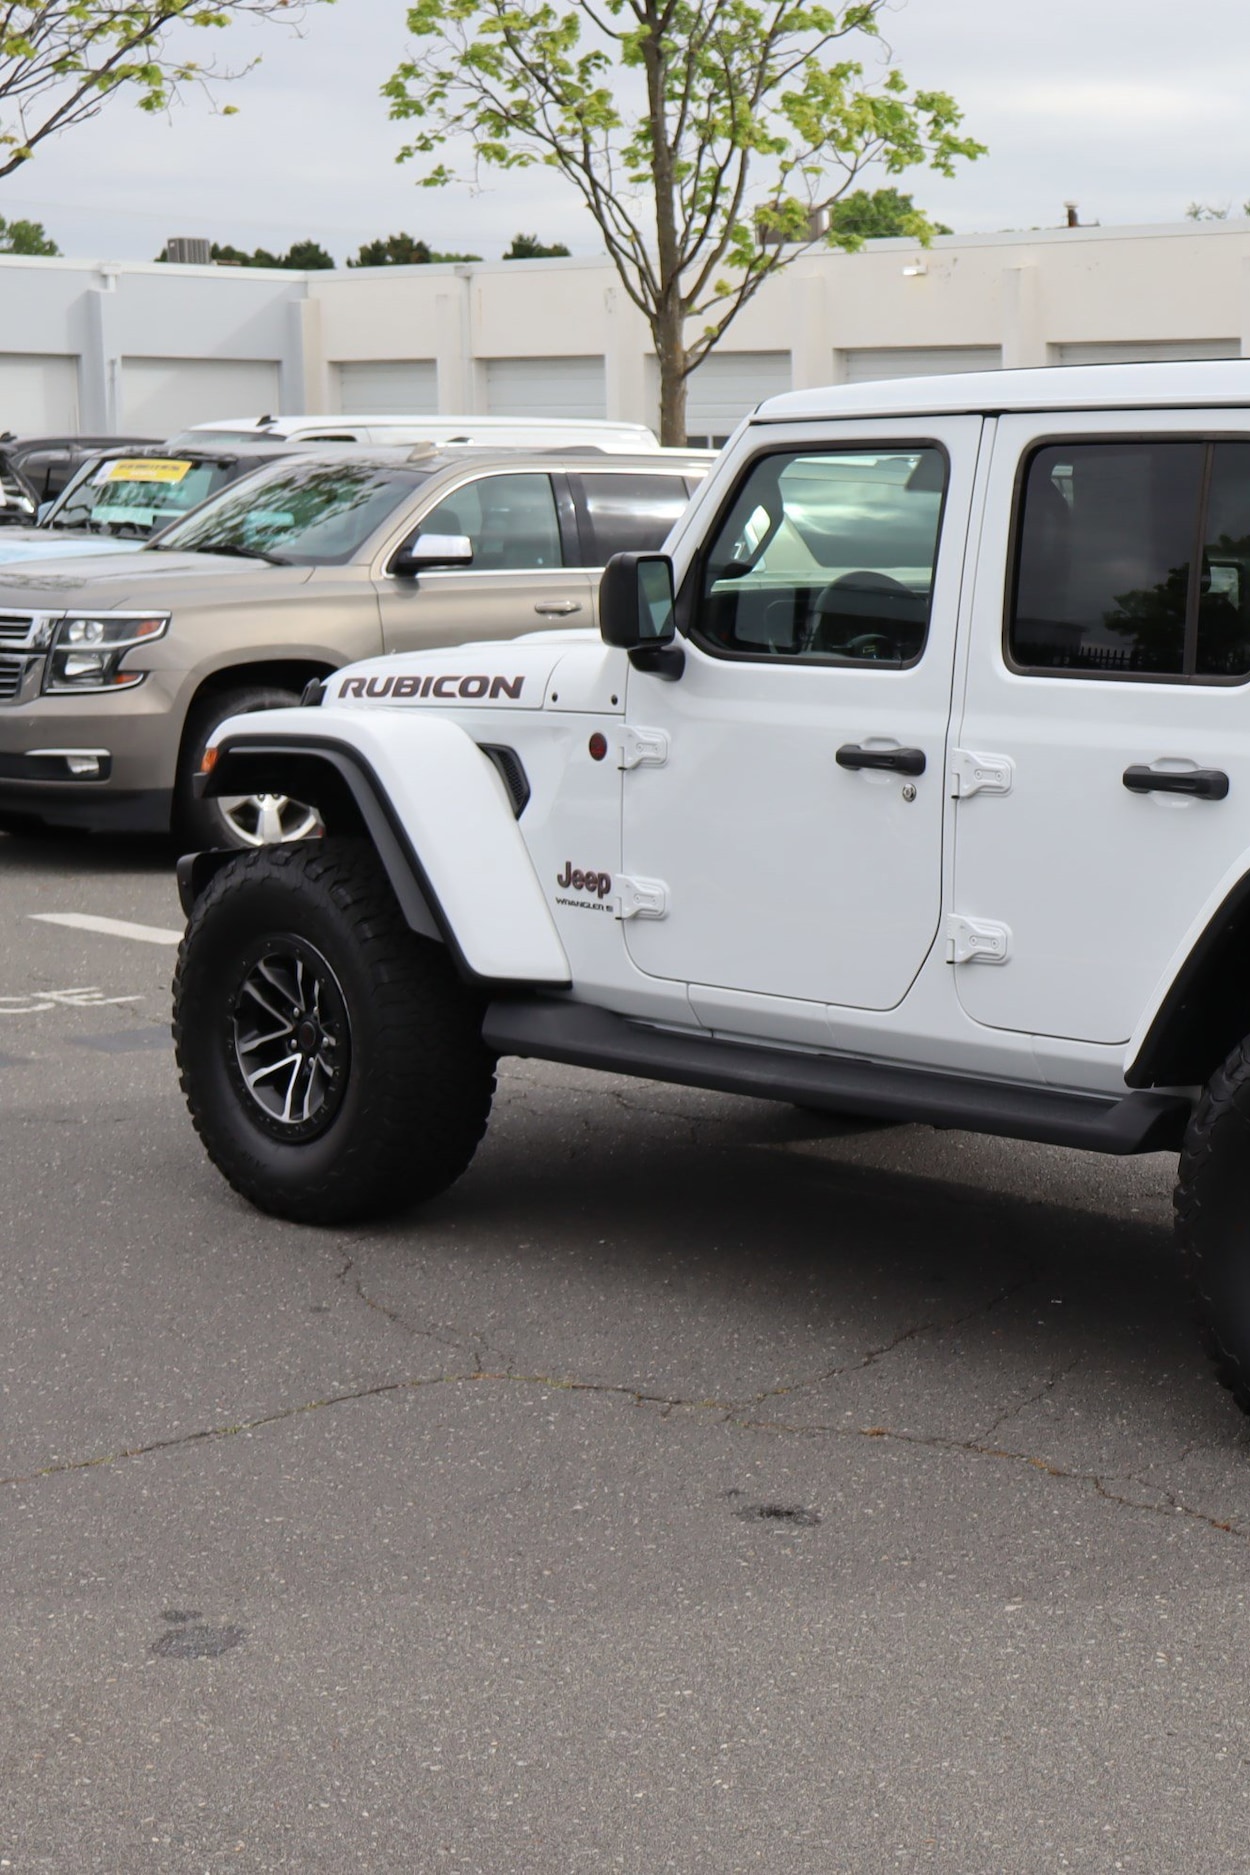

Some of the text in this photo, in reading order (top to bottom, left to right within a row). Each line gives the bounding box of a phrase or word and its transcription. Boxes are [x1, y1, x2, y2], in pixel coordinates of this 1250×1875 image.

[338, 676, 525, 699] RUBICON
[557, 861, 611, 899] Jeep
[556, 897, 604, 911] WRANGLER
